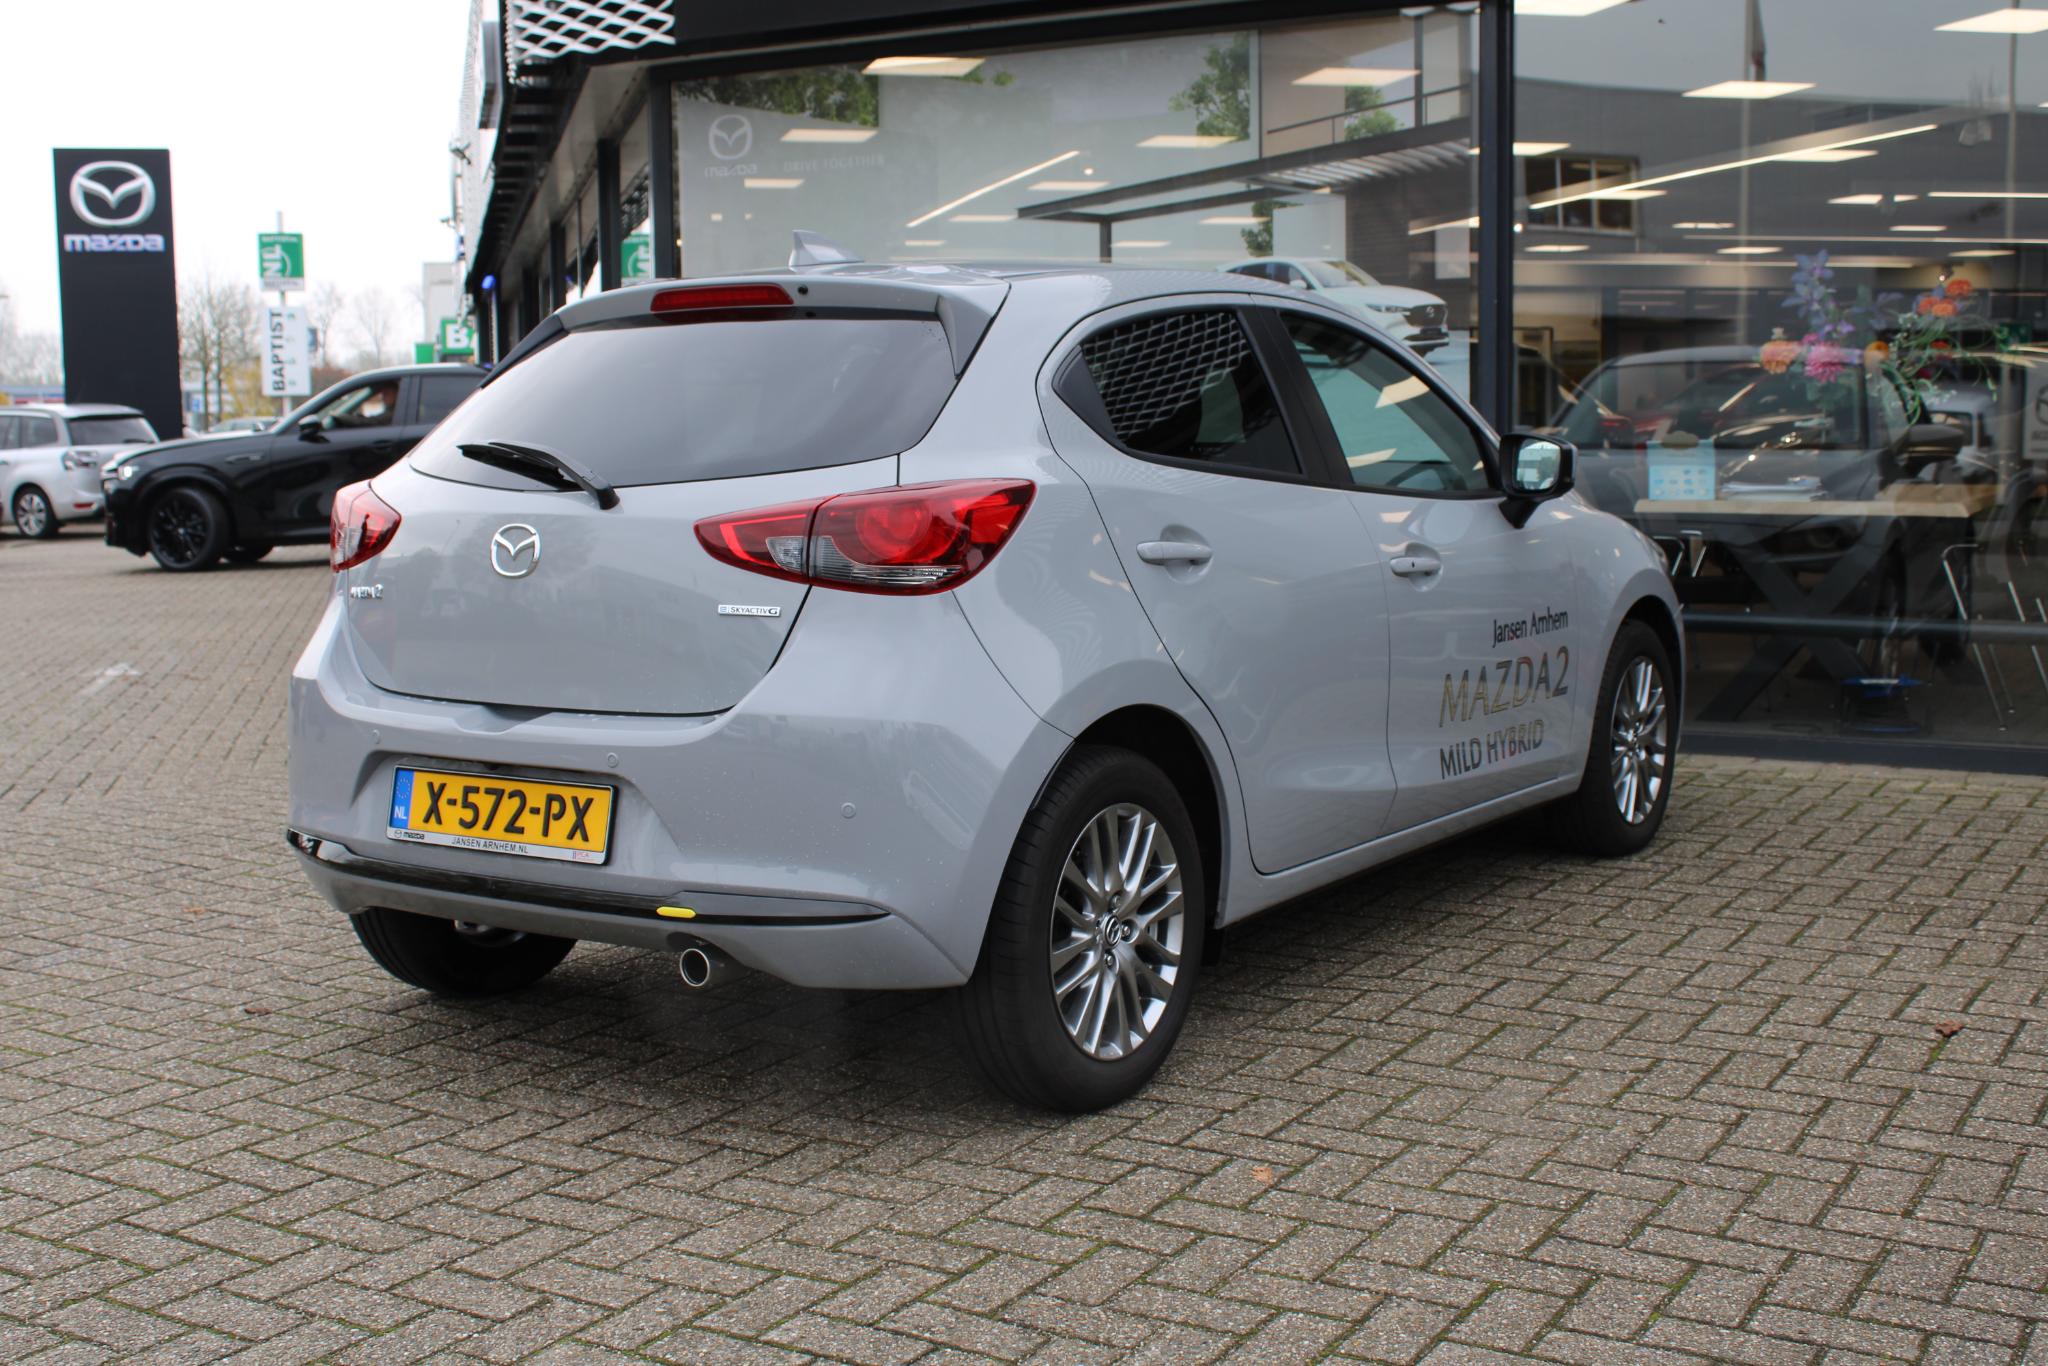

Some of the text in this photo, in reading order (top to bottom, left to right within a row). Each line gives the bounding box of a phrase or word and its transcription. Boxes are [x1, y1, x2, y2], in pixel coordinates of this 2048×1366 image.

[63, 233, 166, 252] mazda
[270, 310, 286, 391] BAPTIST
[1492, 606, 1569, 648] Jansen Arnhem
[1439, 645, 1569, 728] MAZDA2
[1439, 719, 1545, 780] MILD HYBRID
[393, 806, 407, 820] NL
[422, 781, 595, 843] X-572-PX
[451, 836, 481, 849] JANSEN
